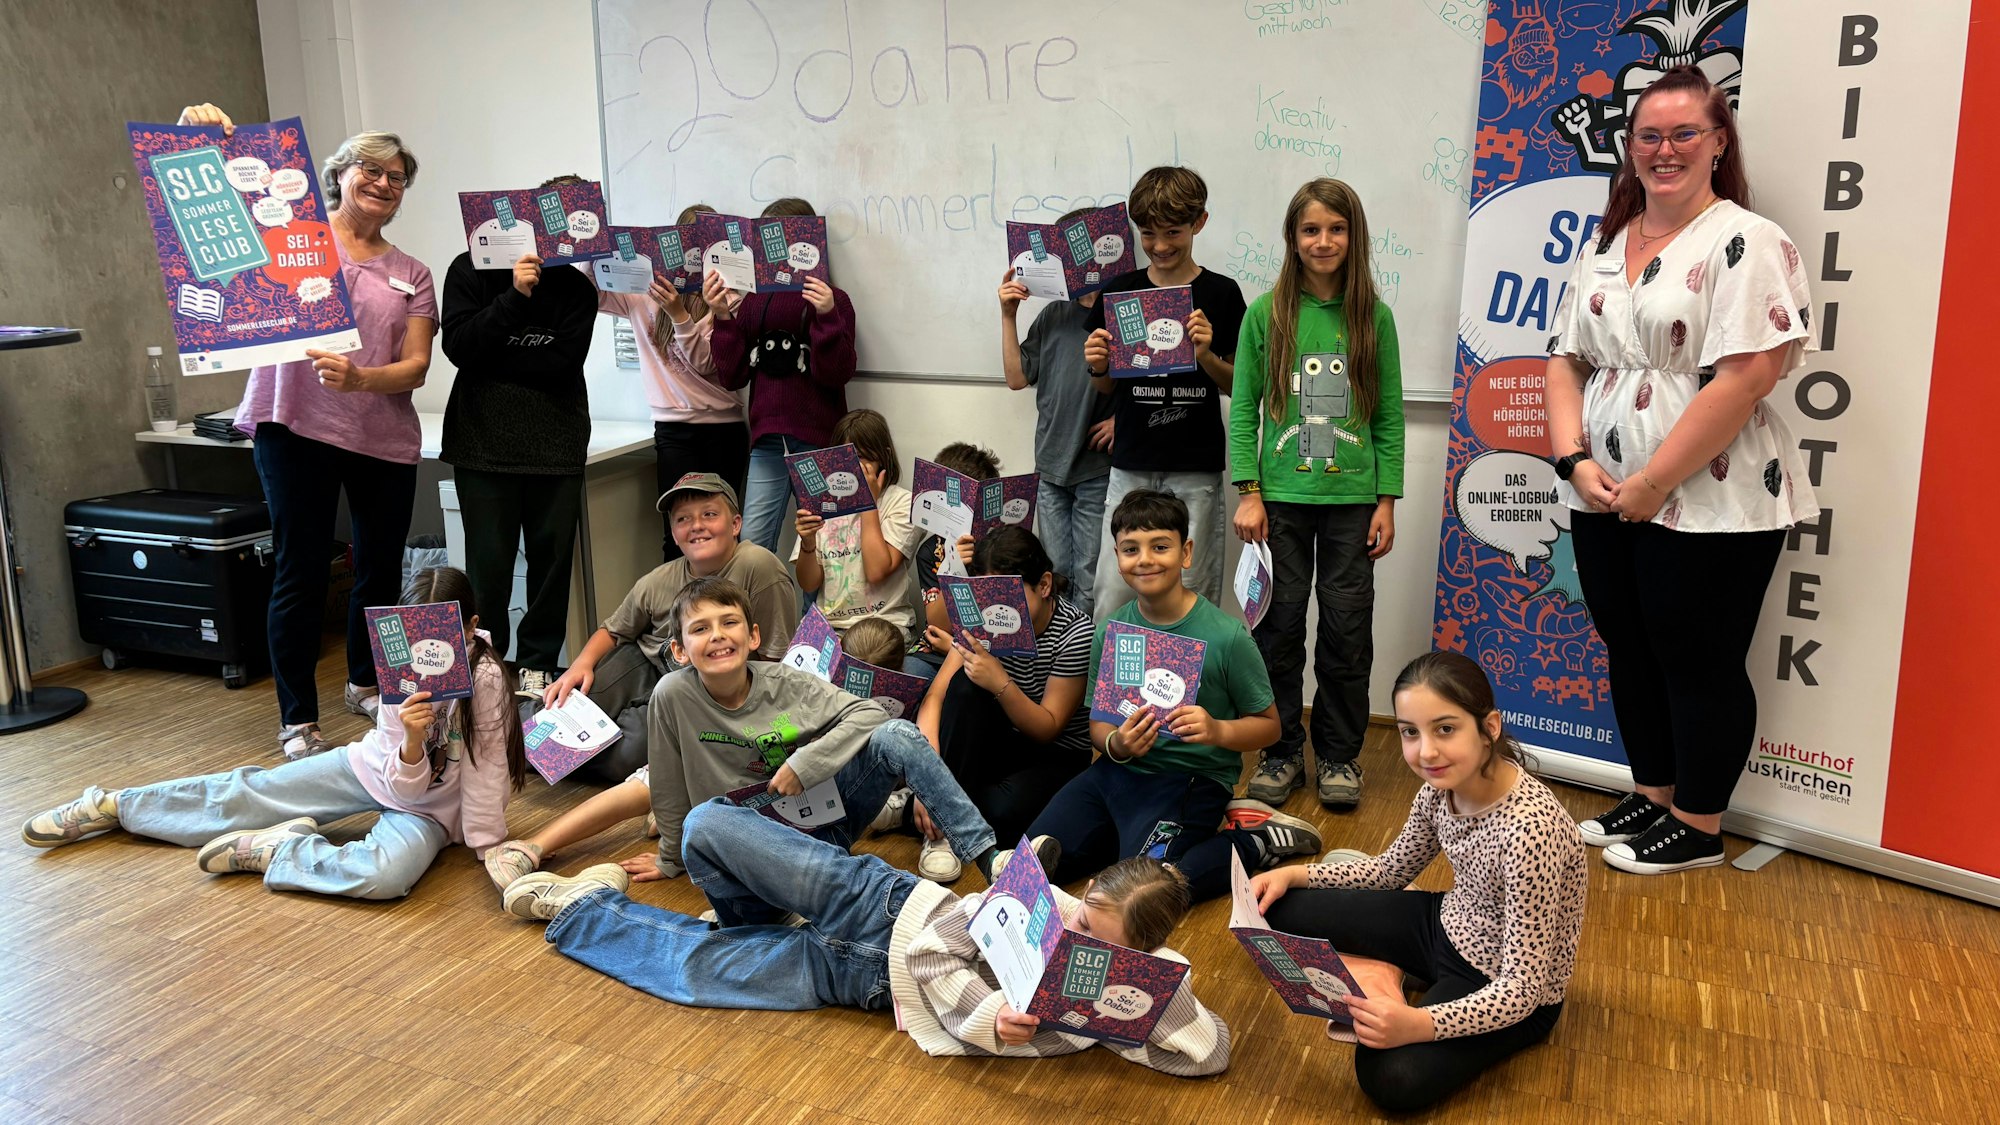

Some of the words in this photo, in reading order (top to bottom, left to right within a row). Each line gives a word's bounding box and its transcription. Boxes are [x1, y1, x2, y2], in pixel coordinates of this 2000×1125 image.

[167, 163, 223, 200] SLC
[182, 199, 232, 219] SOMMER
[541, 196, 558, 210] SLC
[190, 214, 242, 242] LESE
[578, 218, 589, 226] Sei
[572, 225, 593, 233] Dabei!
[763, 226, 780, 239] SLC
[1069, 227, 1085, 239] SLC
[287, 234, 309, 249] SEI
[661, 235, 678, 246] SLC
[1369, 227, 1424, 259] edien-
[200, 237, 252, 264] CLUB
[769, 250, 785, 259] CLUB
[278, 252, 326, 267] DABEI!
[792, 255, 813, 265] Dabei!
[1118, 303, 1139, 318] SLC
[227, 316, 297, 332] SOMMERLESECLUB.DE
[1124, 322, 1142, 333] LESE
[1126, 330, 1144, 340] CLUB
[1159, 328, 1171, 336] Sei
[1152, 334, 1176, 344] Dabei!
[1776, 15, 1878, 686] BIBLIOTHEK
[1490, 377, 1516, 390] NEUE
[1133, 386, 1165, 397] CRISTIANO
[1172, 387, 1206, 397] RONALDO
[1510, 393, 1543, 405] LESEN
[1494, 407, 1548, 421] HÖRBÜCH
[1508, 424, 1544, 437] HÖREN
[799, 461, 815, 474] SLC
[1505, 474, 1526, 487] DAS
[986, 486, 1000, 498] SLC
[1491, 509, 1542, 522] EROBERN
[954, 588, 970, 600] SLC
[848, 601, 885, 615] FEELNGS
[960, 607, 976, 615] LESE
[963, 615, 979, 623] CLUB
[988, 620, 1014, 628] Dabei!
[380, 620, 400, 636] SLC
[386, 641, 405, 653] LESE
[1120, 639, 1140, 653] SLC
[390, 651, 407, 662] CLUB
[425, 650, 439, 659] Sei
[417, 657, 445, 668] Dabei!
[1120, 662, 1140, 671] LESE
[850, 671, 869, 685] SLC
[1120, 672, 1140, 680] CLUB
[1157, 679, 1171, 692] Sei
[1147, 683, 1173, 703] Dabei!
[1500, 709, 1613, 744] MMERLESECLUB.DE
[699, 731, 754, 748] MINECRAFT
[1760, 737, 1854, 772] kulturhof
[1746, 760, 1851, 797] uskirchen
[1780, 782, 1800, 792] stadt
[1803, 788, 1817, 797] mit
[1820, 792, 1850, 805] gesicht
[1076, 951, 1105, 970] SLC
[1074, 967, 1101, 977] SOMMER
[1072, 976, 1099, 986] LESE
[1069, 984, 1097, 995] CLUB
[1103, 997, 1136, 1016] Dabei!
[1117, 994, 1134, 1007] Sei
